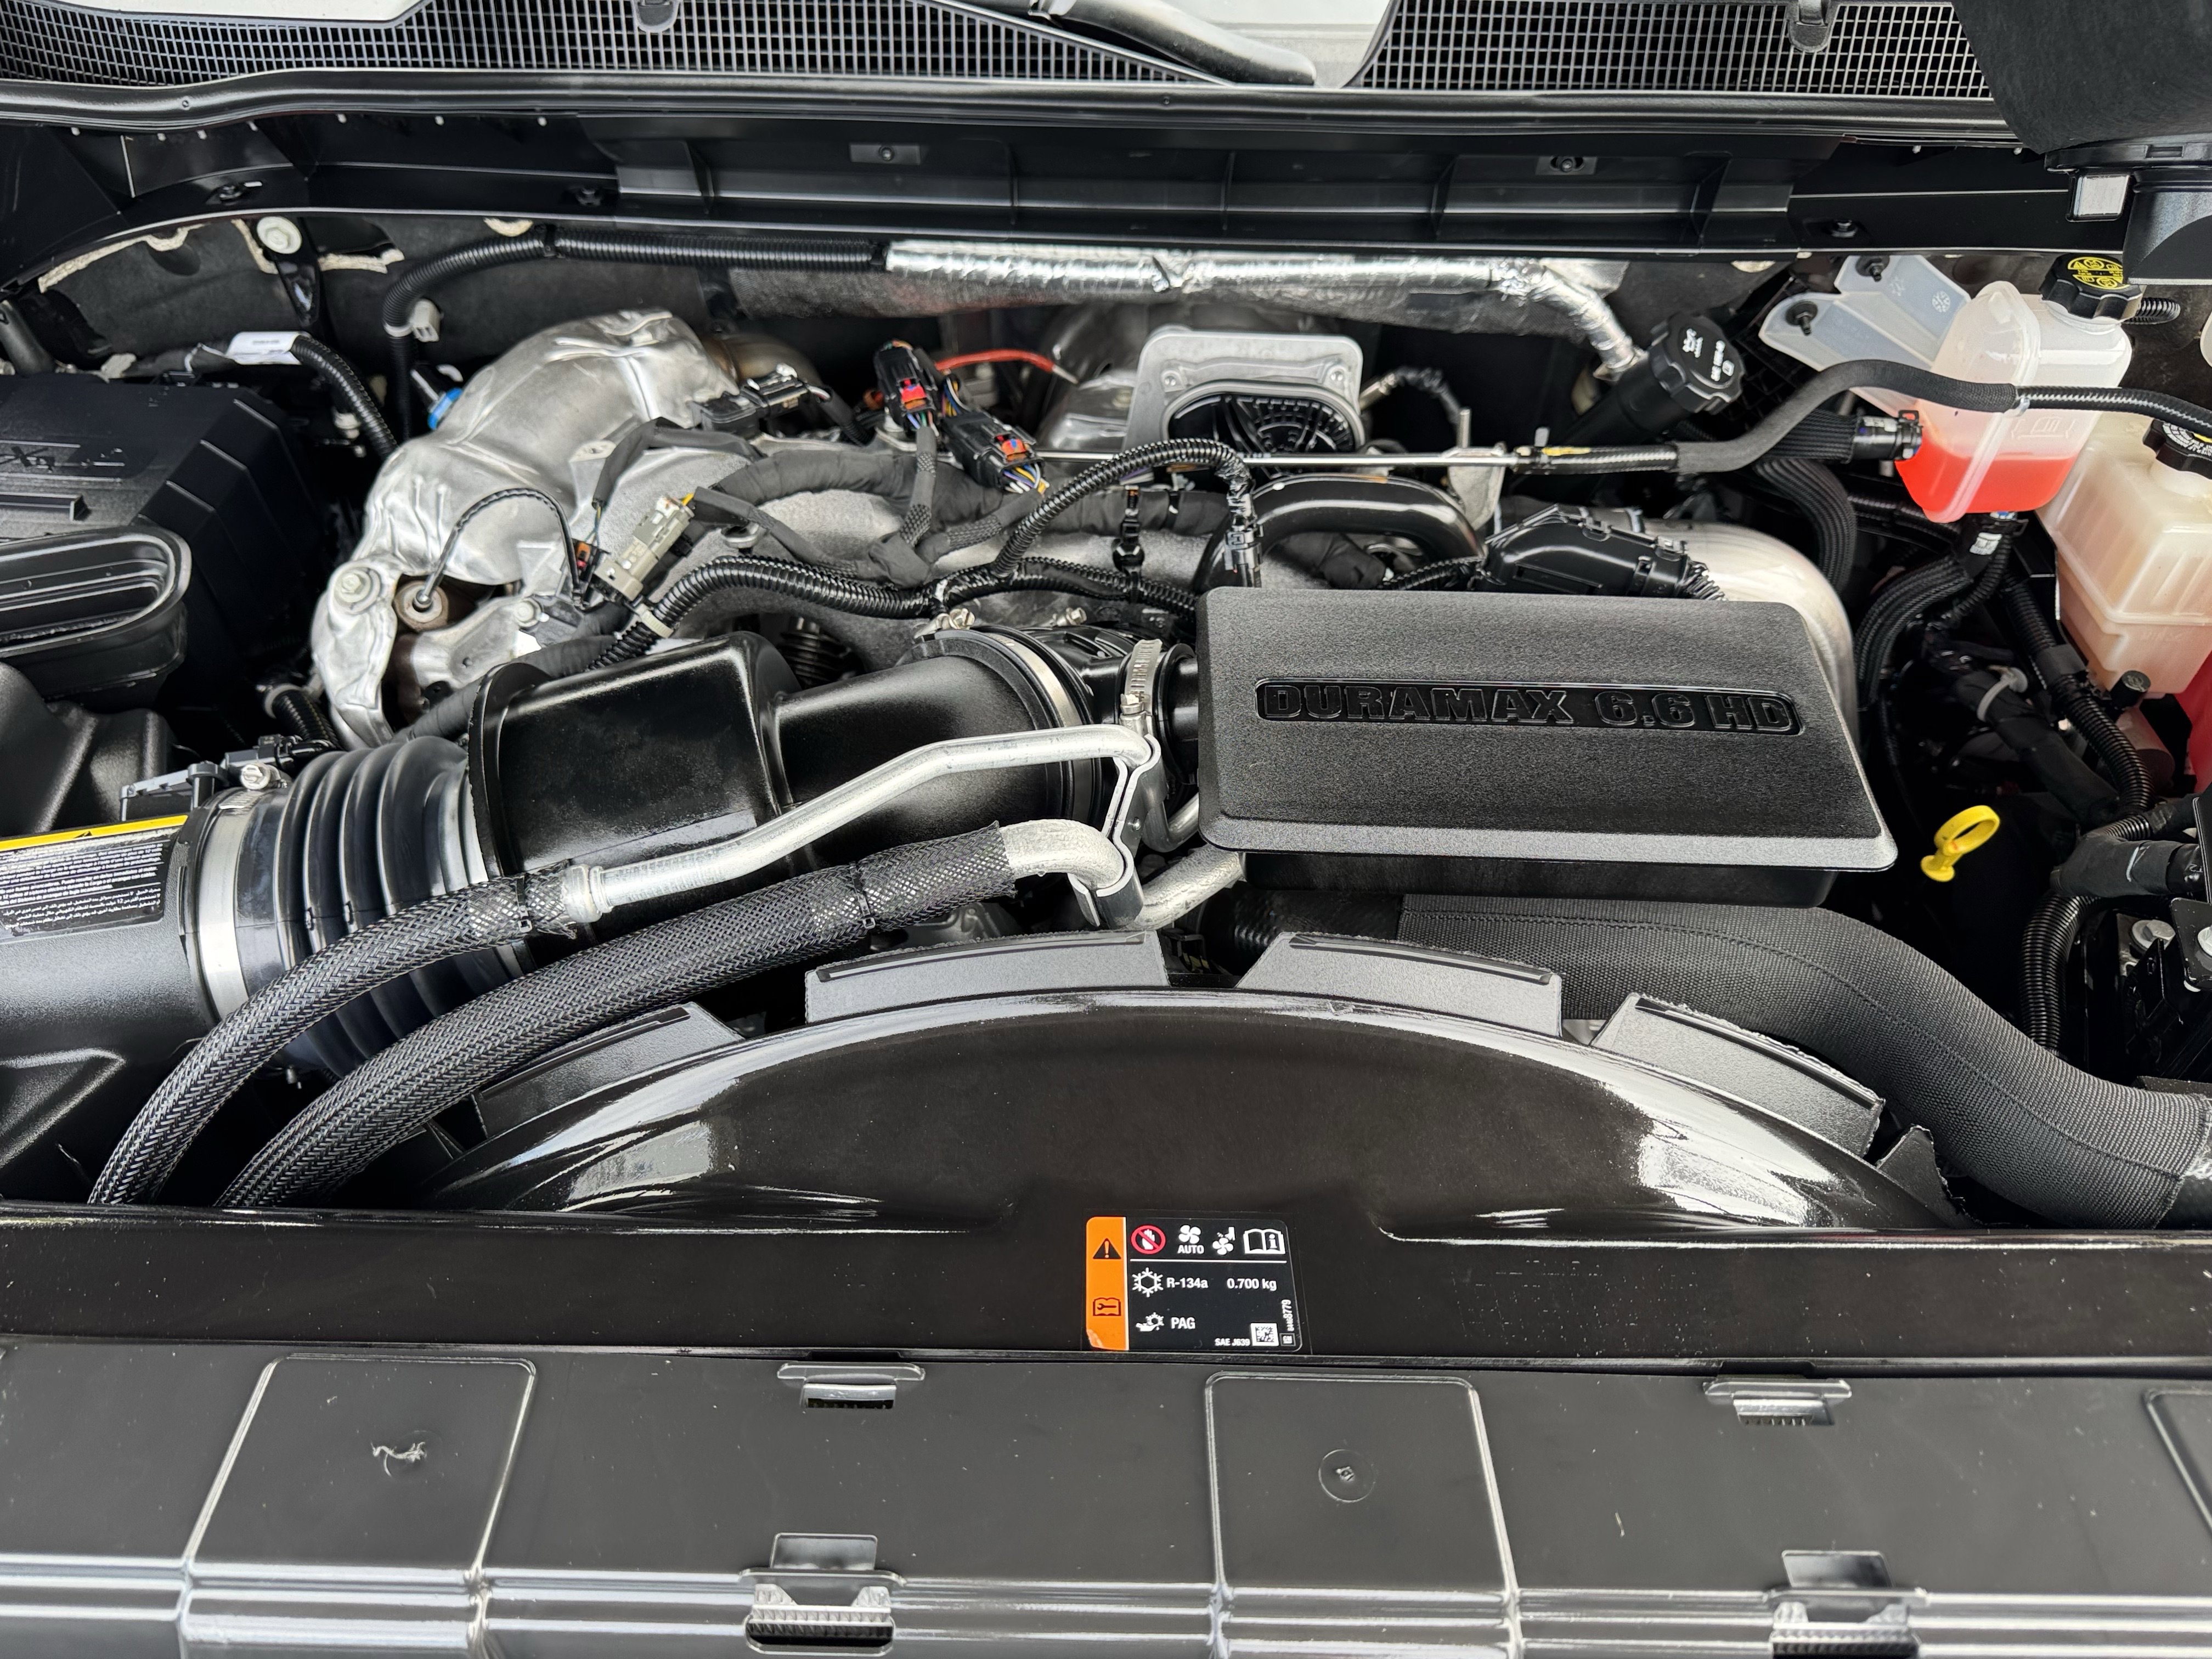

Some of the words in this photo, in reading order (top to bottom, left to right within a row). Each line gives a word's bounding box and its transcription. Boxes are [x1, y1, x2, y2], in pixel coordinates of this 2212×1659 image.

[1263, 685, 1573, 724] DURAMAX
[1594, 691, 1695, 728] 6.6
[1707, 695, 1794, 732] HD
[1177, 1245, 1204, 1254] AUTO
[1167, 1278, 1208, 1288] R-134a
[1227, 1278, 1259, 1289] 0.700
[1262, 1279, 1277, 1291] kg
[1171, 1317, 1195, 1329] PAG
